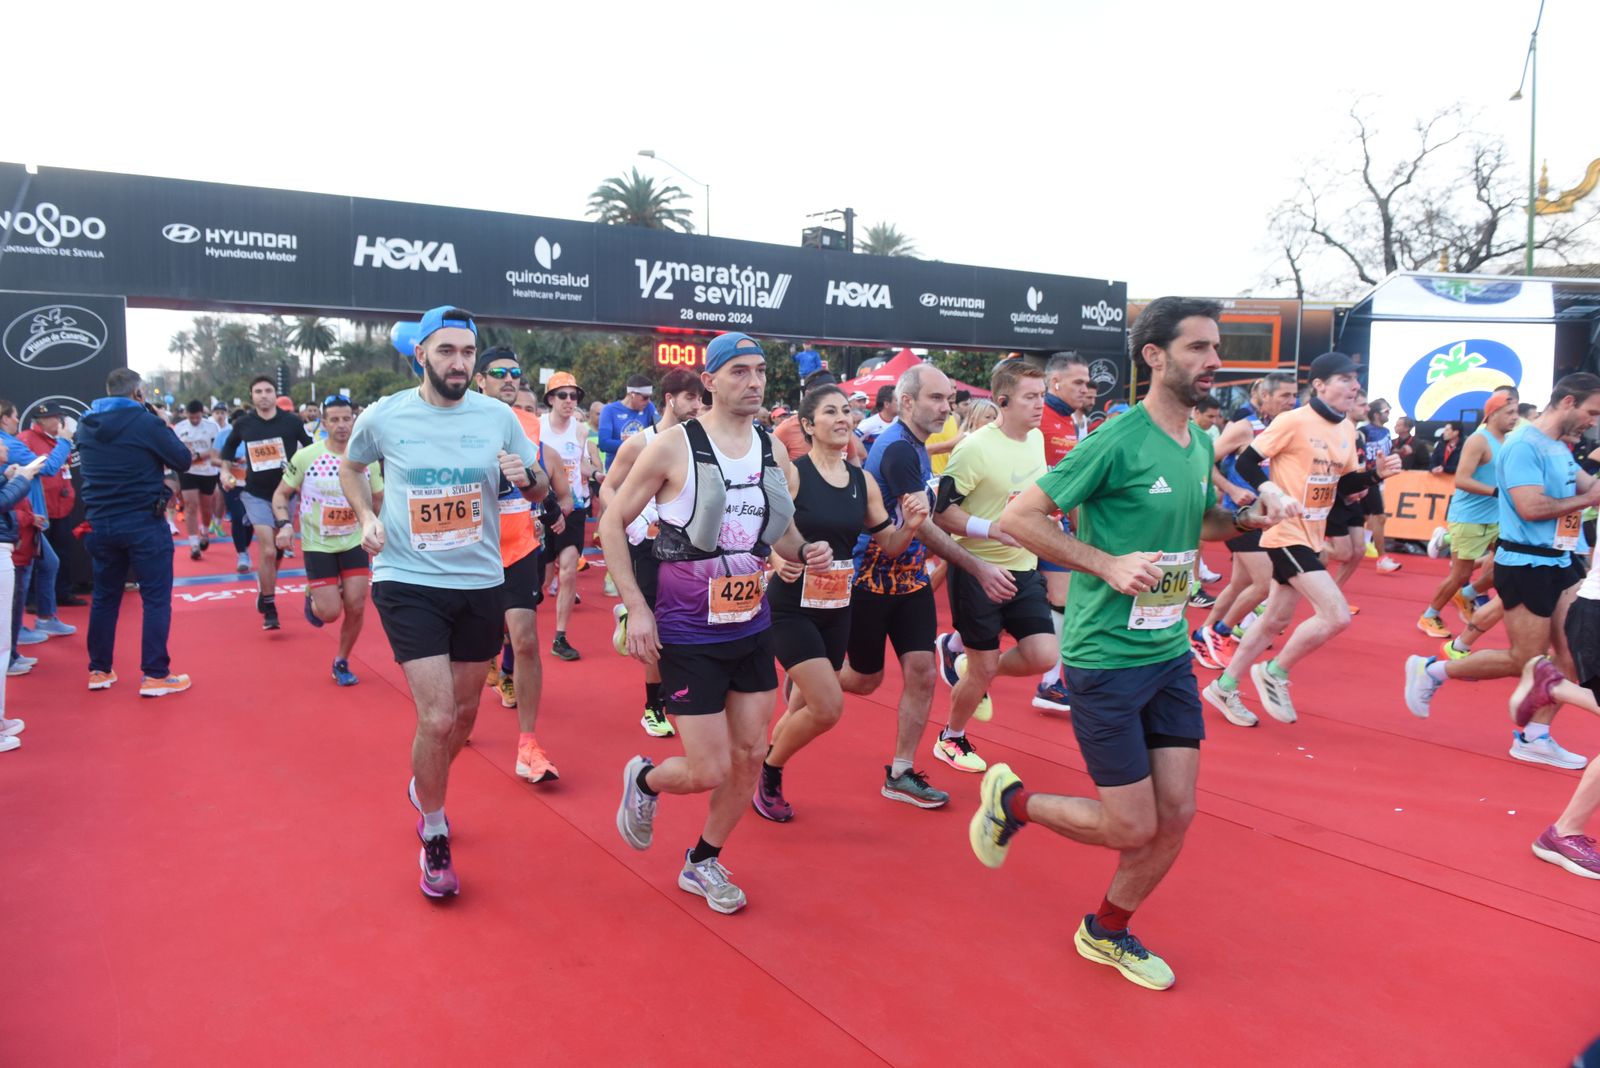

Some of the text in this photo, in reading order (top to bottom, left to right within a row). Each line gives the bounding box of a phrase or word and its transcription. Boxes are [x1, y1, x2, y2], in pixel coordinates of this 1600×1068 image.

[205, 228, 297, 249] HYUNDAI
[205, 246, 297, 262] Hyundauto Motor
[353, 235, 459, 273] HOKA
[666, 262, 770, 288] maratón
[512, 288, 582, 301] Healthcare Partner
[694, 284, 772, 308] sevilla
[825, 280, 892, 309] HOKA
[939, 296, 985, 309] HYUNDAI
[680, 308, 753, 324] 28 enero 2024
[254, 446, 276, 457] 5633
[420, 501, 466, 522] 5176
[721, 580, 761, 601] 4224
